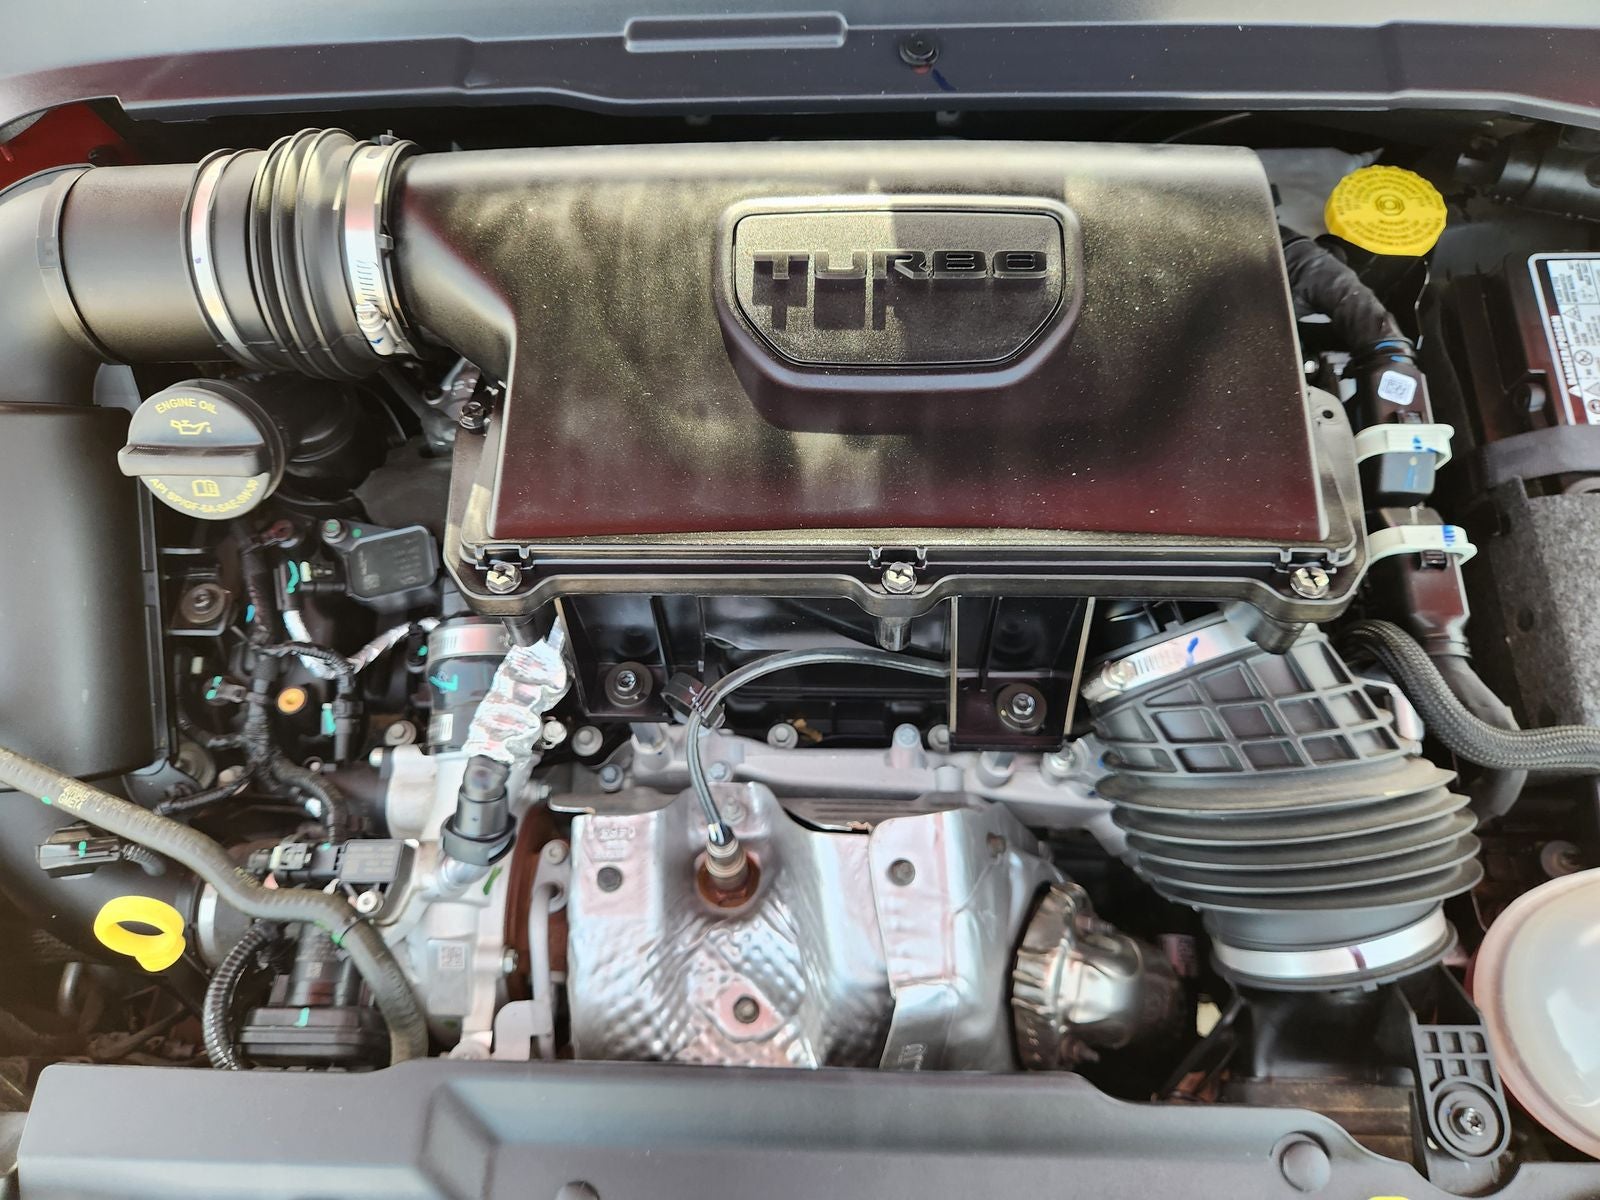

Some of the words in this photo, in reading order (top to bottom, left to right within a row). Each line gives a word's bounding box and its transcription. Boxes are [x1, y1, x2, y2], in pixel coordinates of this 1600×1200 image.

[752, 249, 1048, 280] TURBO
[155, 397, 197, 414] ENGINE
[198, 400, 218, 415] OIL
[149, 478, 168, 494] API
